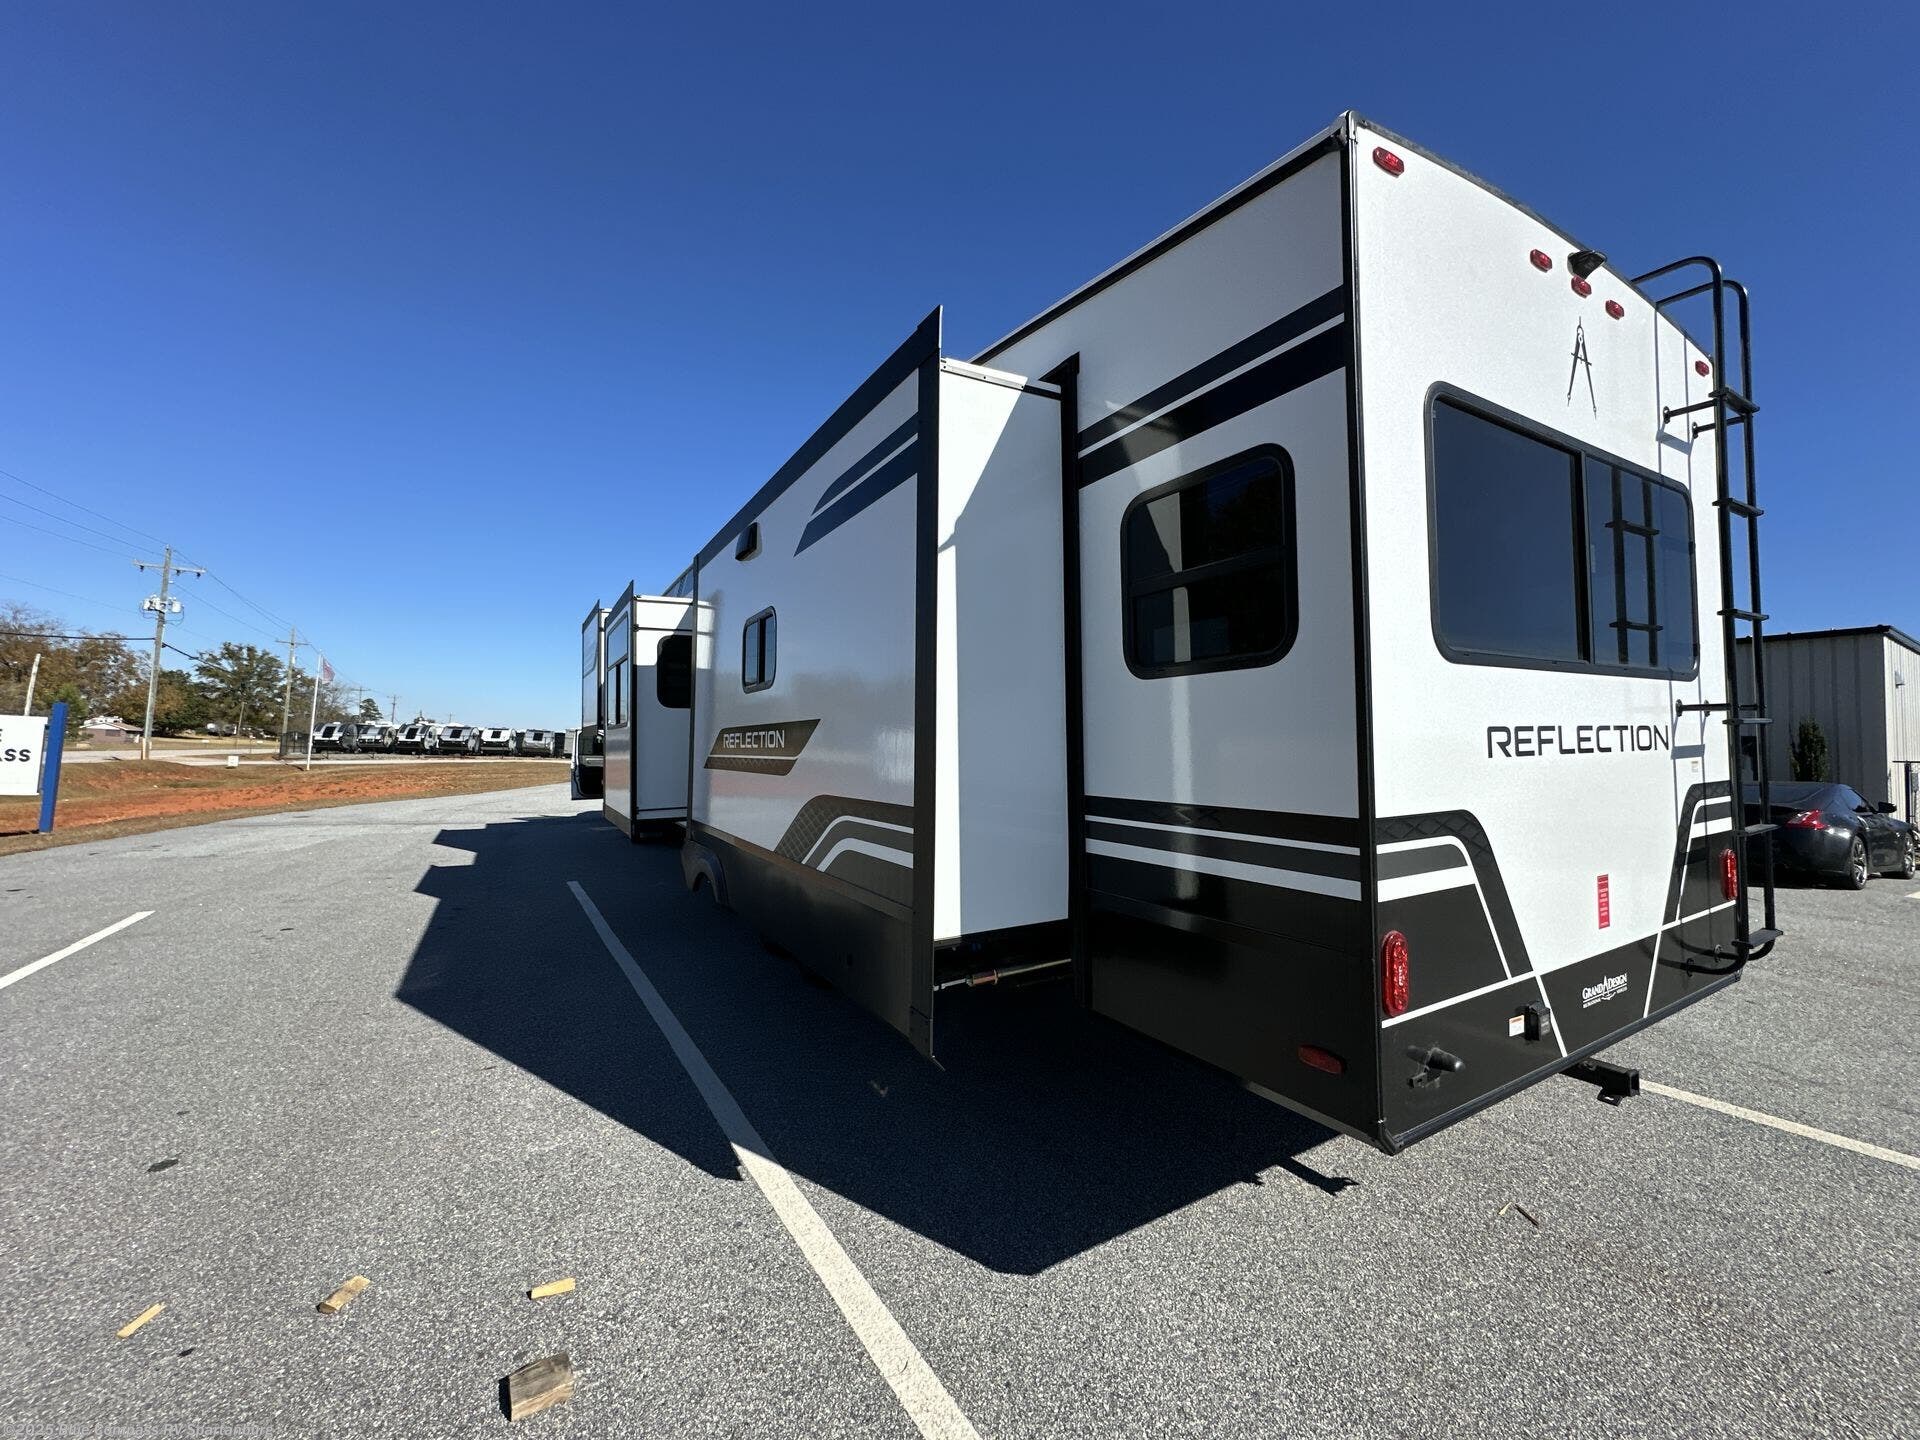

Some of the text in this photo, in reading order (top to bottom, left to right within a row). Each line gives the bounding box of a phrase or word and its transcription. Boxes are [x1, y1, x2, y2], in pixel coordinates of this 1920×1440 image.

[723, 730, 785, 748] REFLECTION
[1487, 725, 1670, 758] REFLECTION
[0, 748, 31, 762] SS
